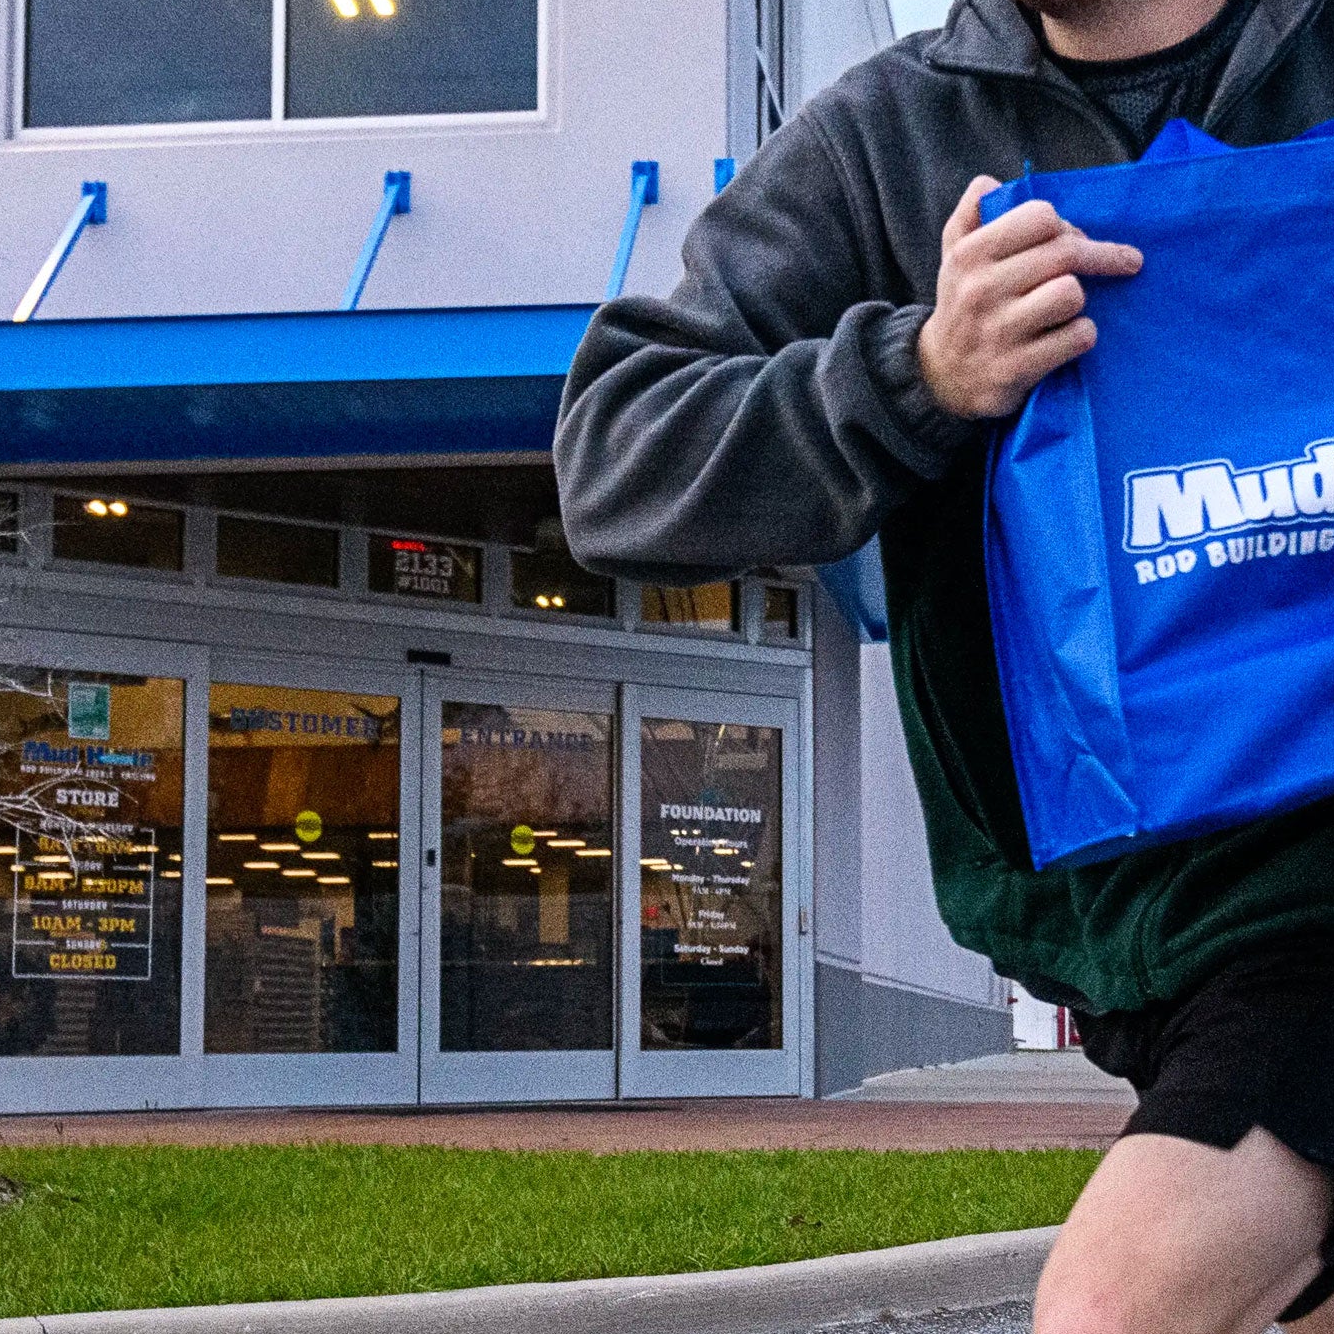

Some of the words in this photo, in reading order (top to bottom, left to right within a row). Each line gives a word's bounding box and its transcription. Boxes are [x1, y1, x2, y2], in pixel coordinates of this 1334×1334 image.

[1135, 552, 1196, 584] ROD
[56, 789, 118, 807] STORE
[660, 803, 762, 823] FOUNDATION
[32, 915, 82, 932] 10AM
[98, 917, 136, 933] 3PM
[49, 953, 117, 970] CLOSED
